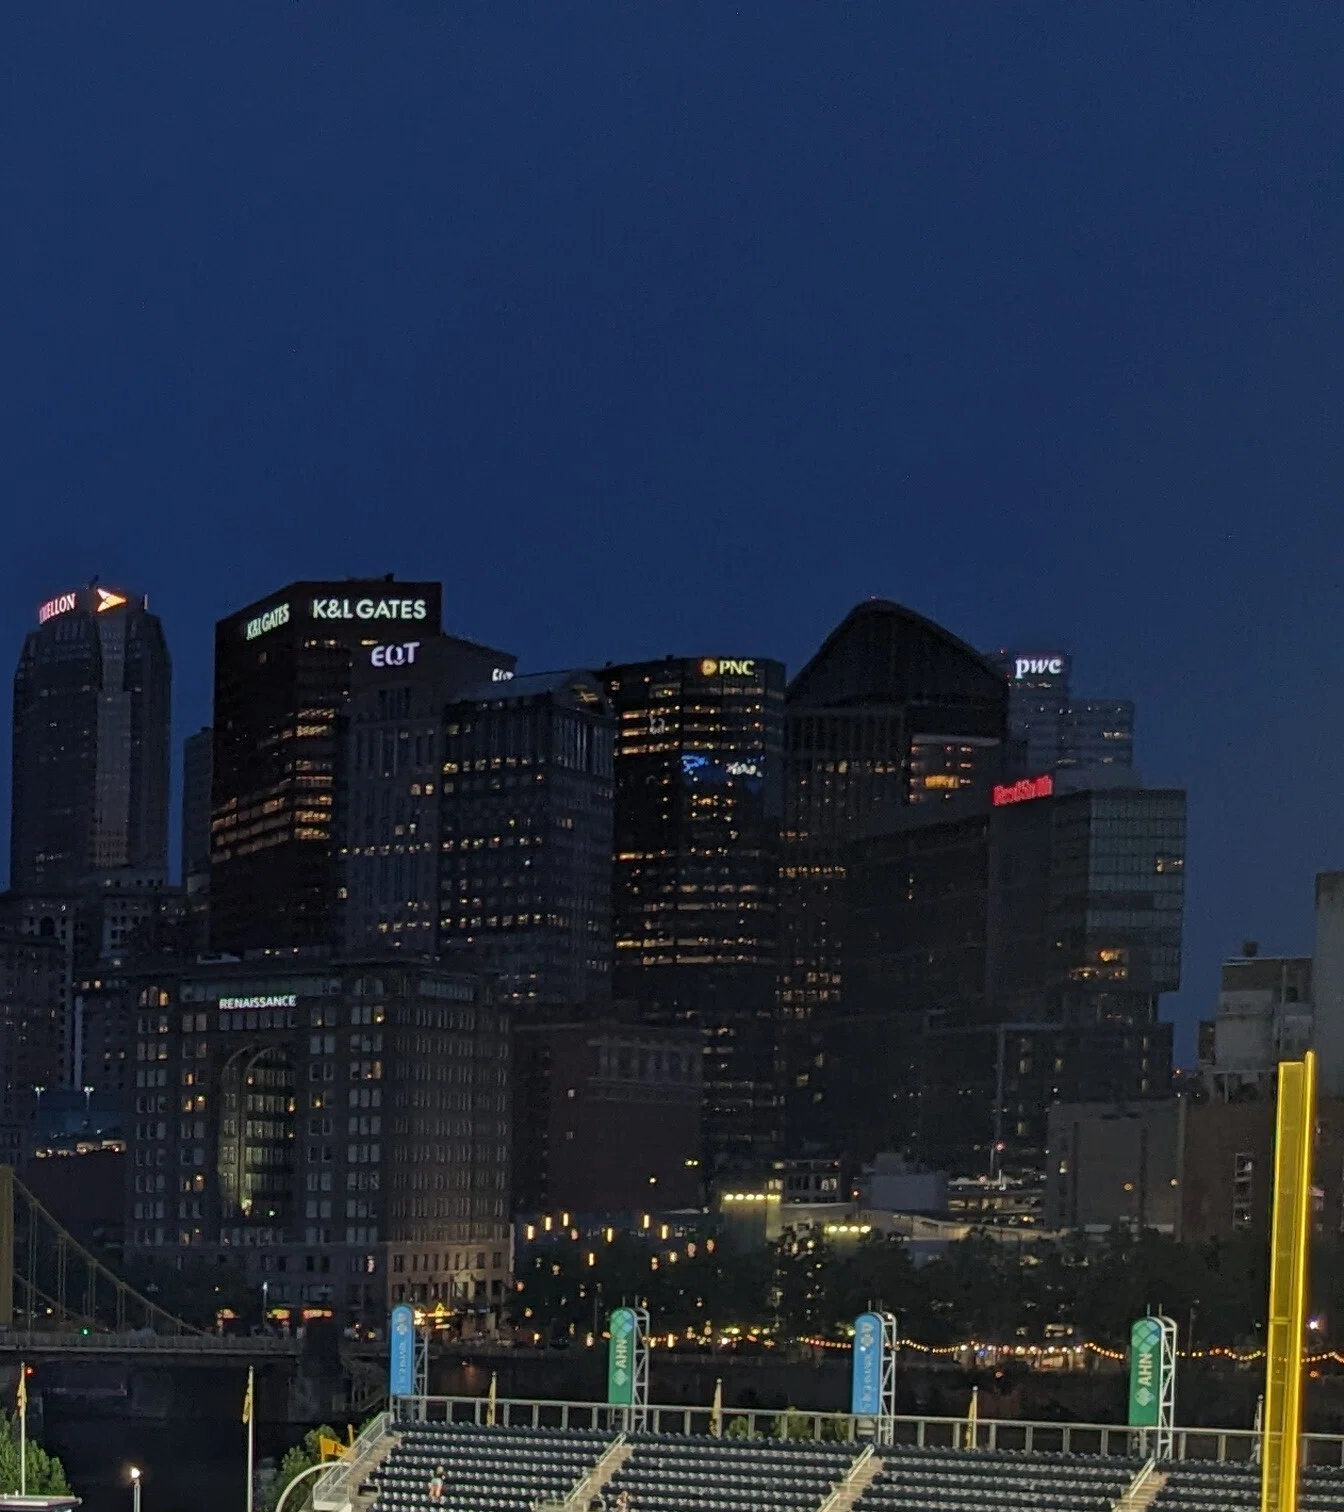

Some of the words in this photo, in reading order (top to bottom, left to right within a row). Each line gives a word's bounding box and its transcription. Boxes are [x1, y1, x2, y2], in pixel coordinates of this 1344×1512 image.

[262, 602, 290, 634] GATES
[313, 599, 352, 619] K&L
[357, 599, 426, 620] GATES
[371, 641, 421, 667] EQT
[719, 658, 755, 677] PNC
[1015, 658, 1062, 679] pwc
[219, 995, 296, 1010] RENAISSANCE
[616, 1338, 627, 1369] AHN
[1138, 1353, 1152, 1388] AHN
